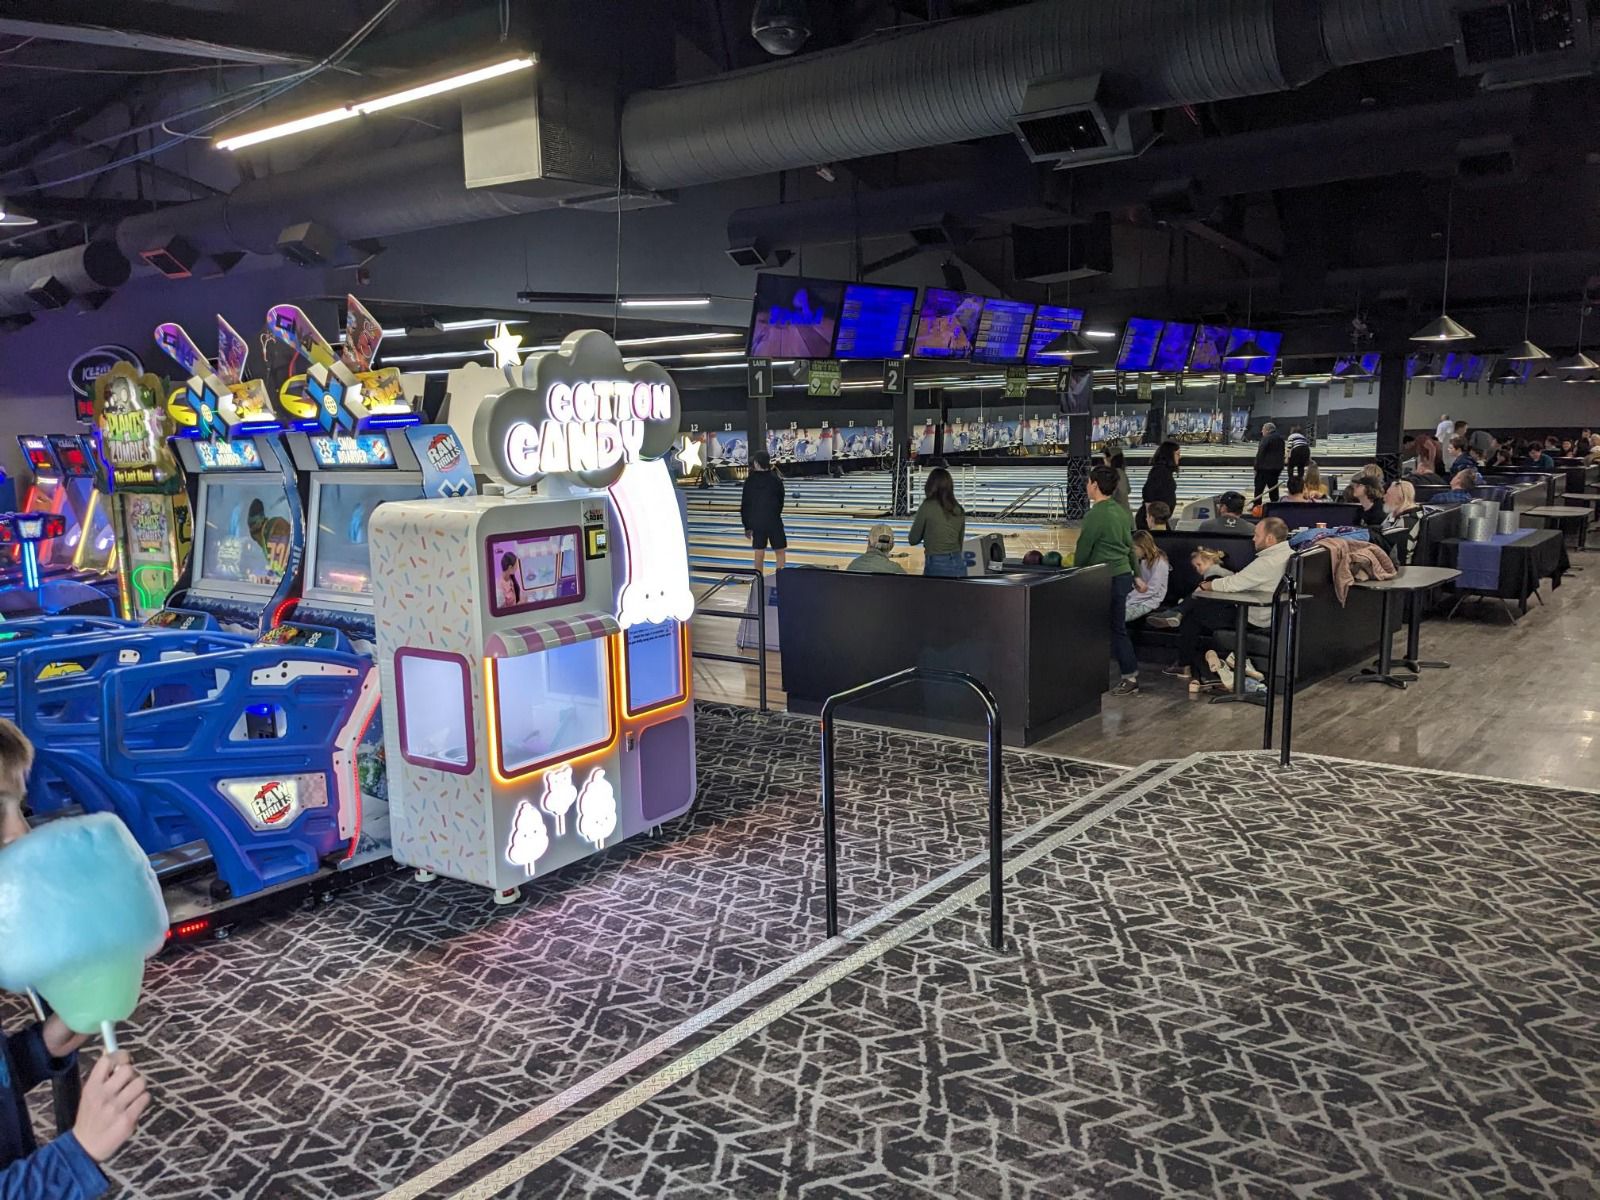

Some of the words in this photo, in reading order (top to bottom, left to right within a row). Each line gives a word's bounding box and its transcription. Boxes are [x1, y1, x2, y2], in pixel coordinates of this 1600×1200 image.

[754, 370, 763, 394] 1
[887, 370, 898, 390] 2
[1060, 374, 1067, 391] 4
[547, 382, 671, 422] COTTON
[107, 411, 146, 436] PLANTS
[690, 424, 699, 432] 12
[109, 440, 152, 462] ZOMBIES
[427, 434, 457, 464] RAW
[434, 446, 461, 472] THRILLS
[507, 419, 646, 476] CANDY
[114, 471, 124, 482] The
[124, 470, 136, 482] Last
[251, 781, 289, 816] RAW
[257, 793, 293, 823] THRILLS
